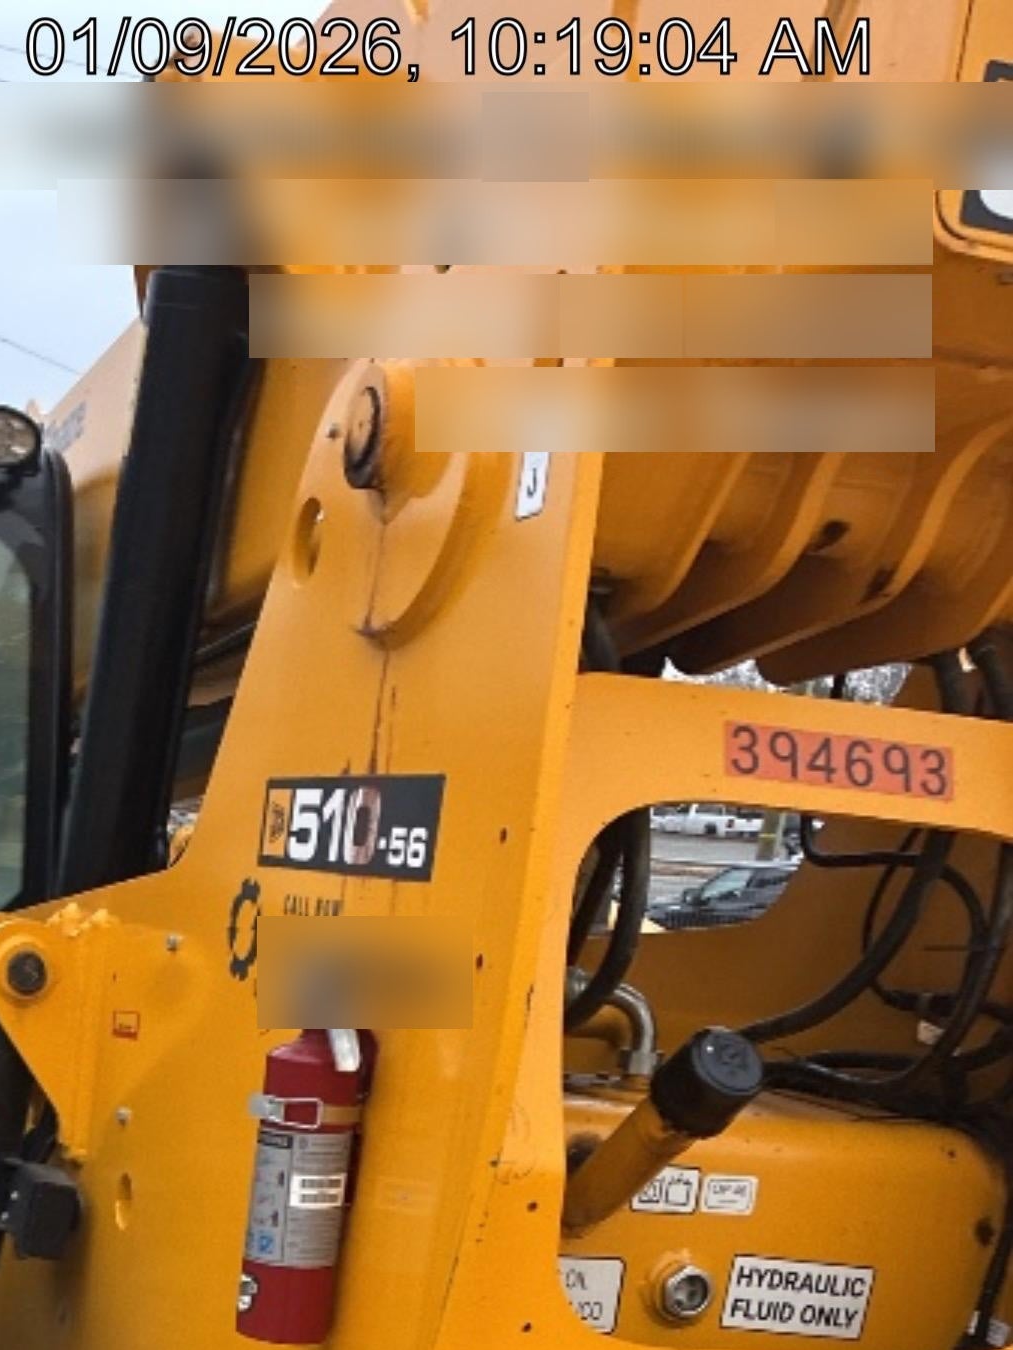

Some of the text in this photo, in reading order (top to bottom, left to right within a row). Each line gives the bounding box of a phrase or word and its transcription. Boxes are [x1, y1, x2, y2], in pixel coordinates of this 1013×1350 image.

[731, 725, 948, 796] 394693
[736, 1265, 866, 1298] HYDRAULIC
[730, 1298, 858, 1330] FLUID ONLY
